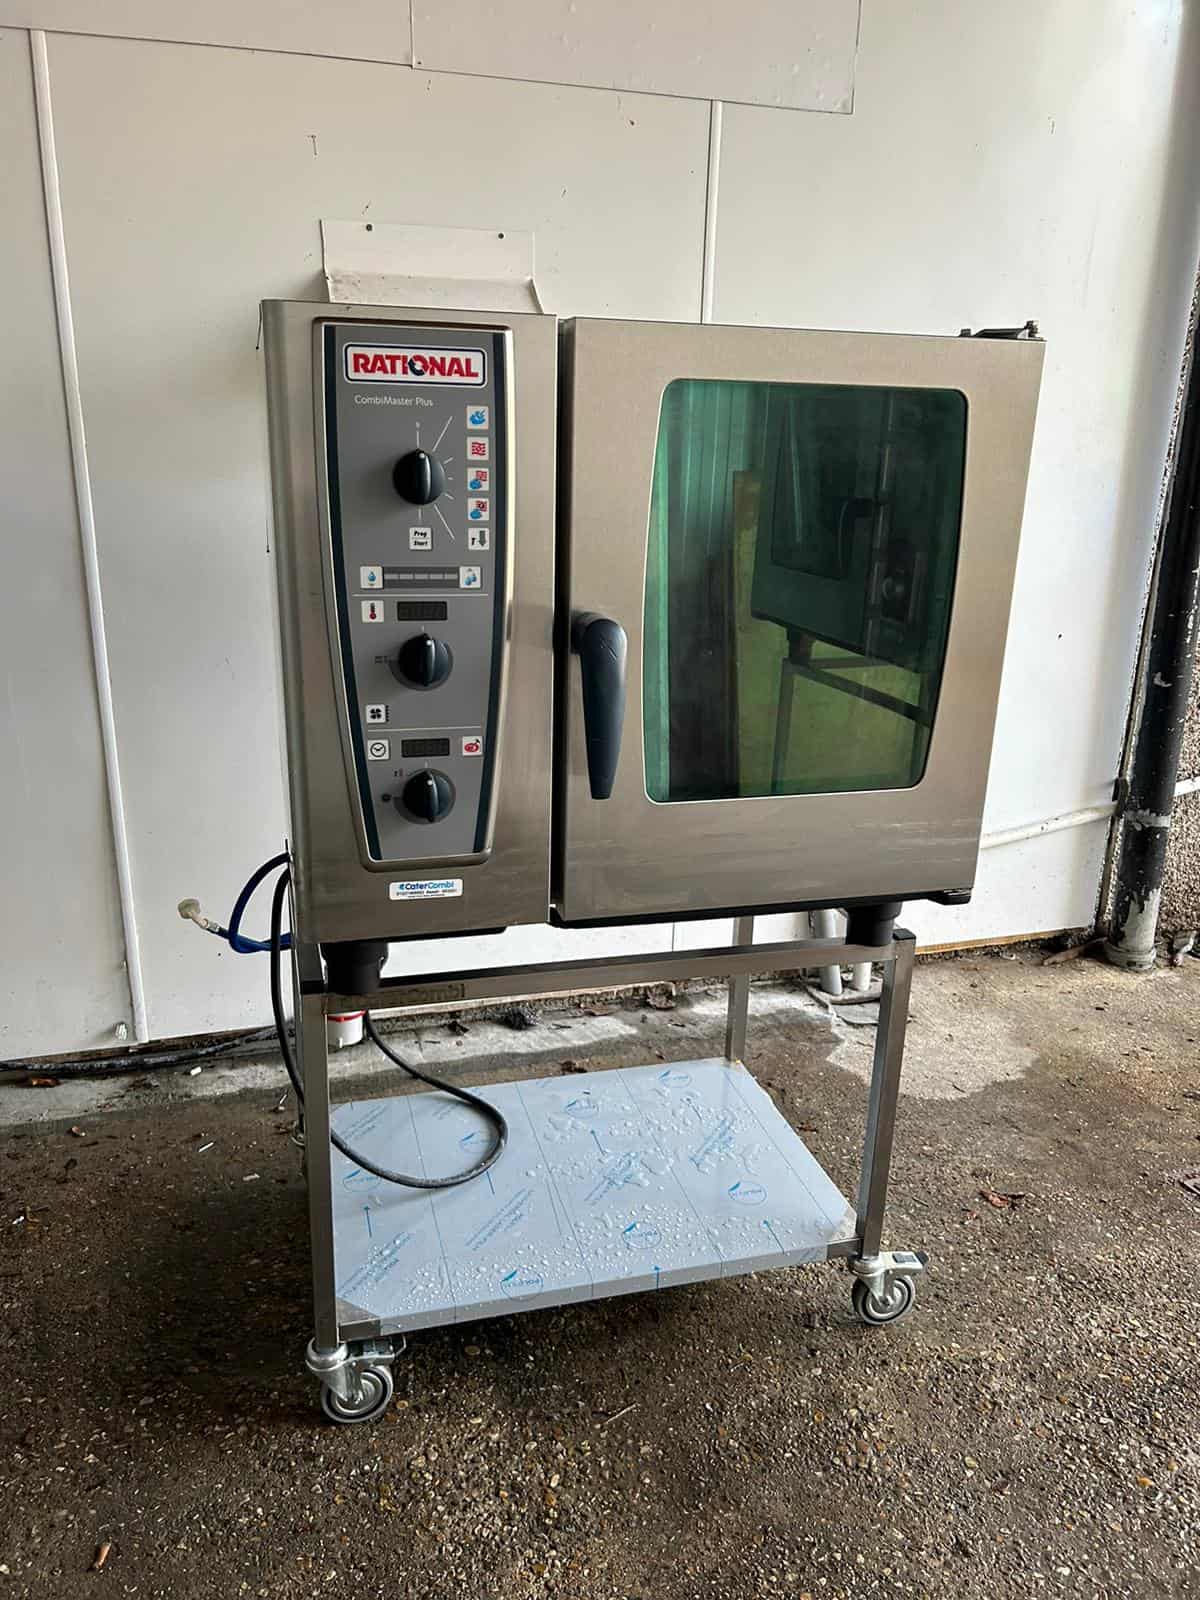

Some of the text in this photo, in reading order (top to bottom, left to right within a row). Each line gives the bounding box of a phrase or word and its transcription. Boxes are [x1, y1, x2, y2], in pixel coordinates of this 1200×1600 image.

[353, 353, 479, 378] RATIONAL
[354, 394, 434, 407] CombiMaster Plus
[414, 530, 428, 538] Prog
[404, 881, 455, 890] CaterCombi
